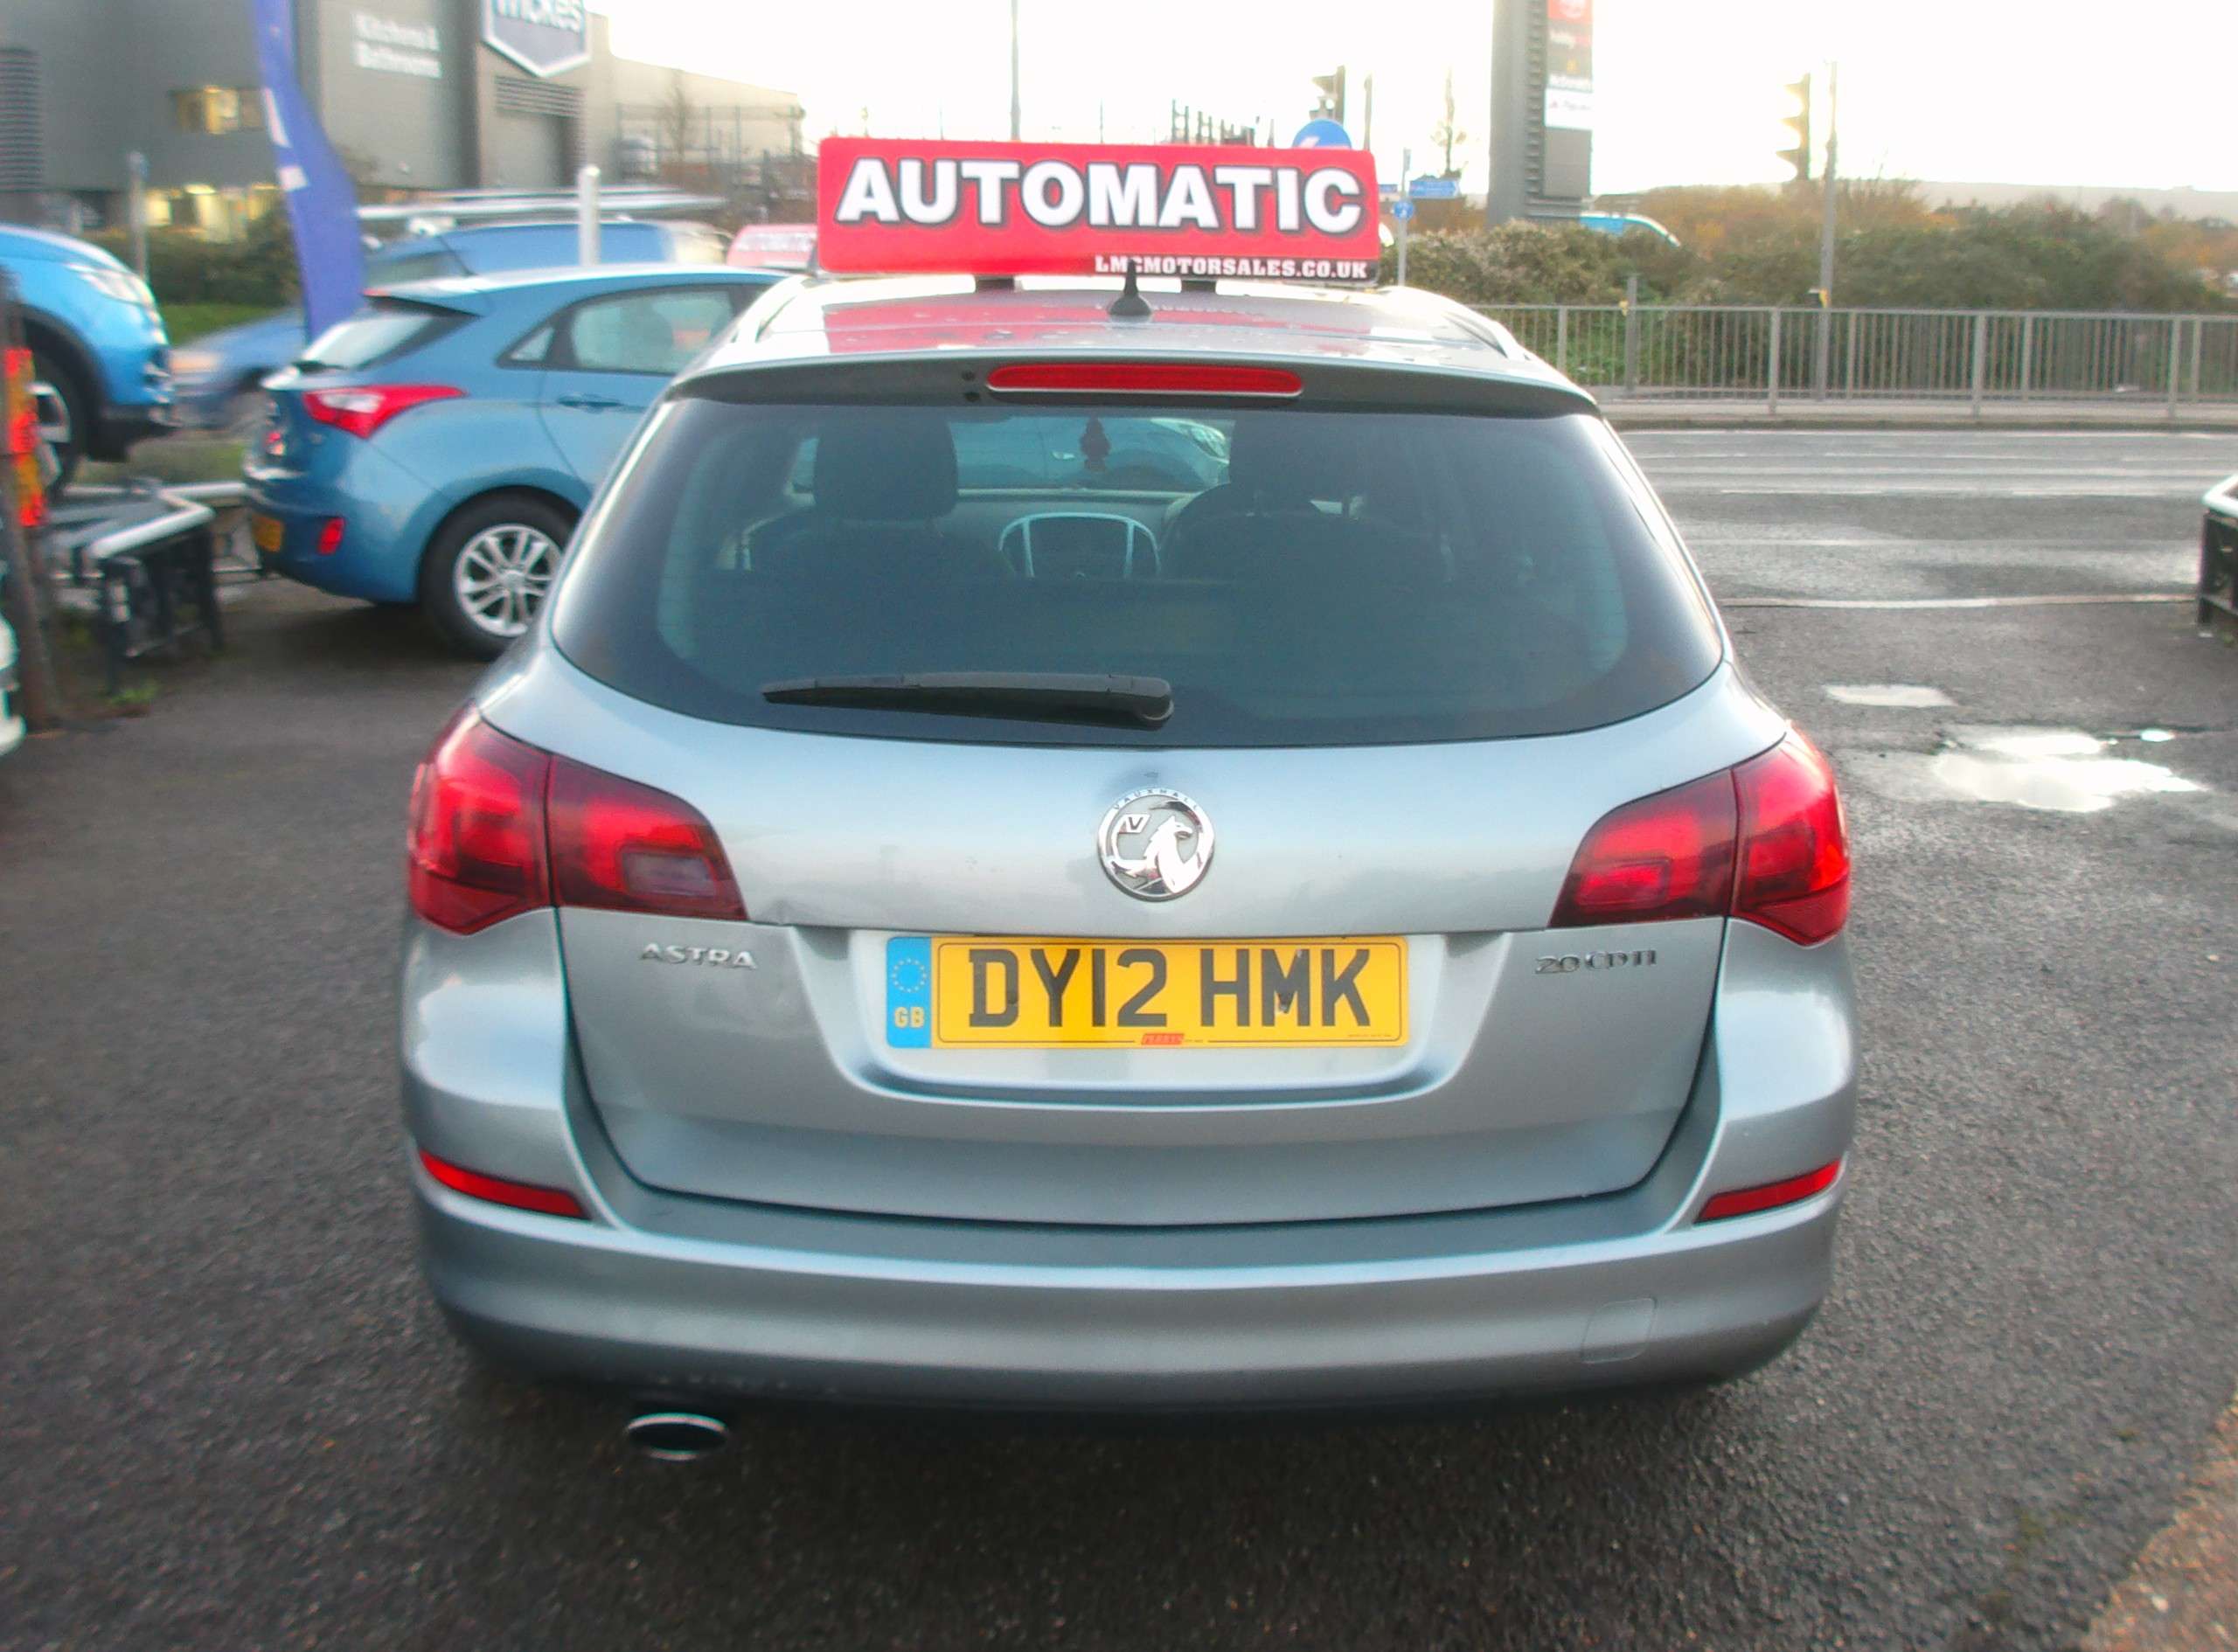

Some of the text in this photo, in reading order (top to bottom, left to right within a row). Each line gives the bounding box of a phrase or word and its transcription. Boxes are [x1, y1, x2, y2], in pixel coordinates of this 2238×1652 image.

[835, 157, 1362, 235] AUTOMATIC
[1113, 788, 1199, 810] VAUXHALL
[639, 942, 757, 969] ASTRA
[968, 947, 1372, 1028] DY12 HMK
[894, 1006, 925, 1028] GB
